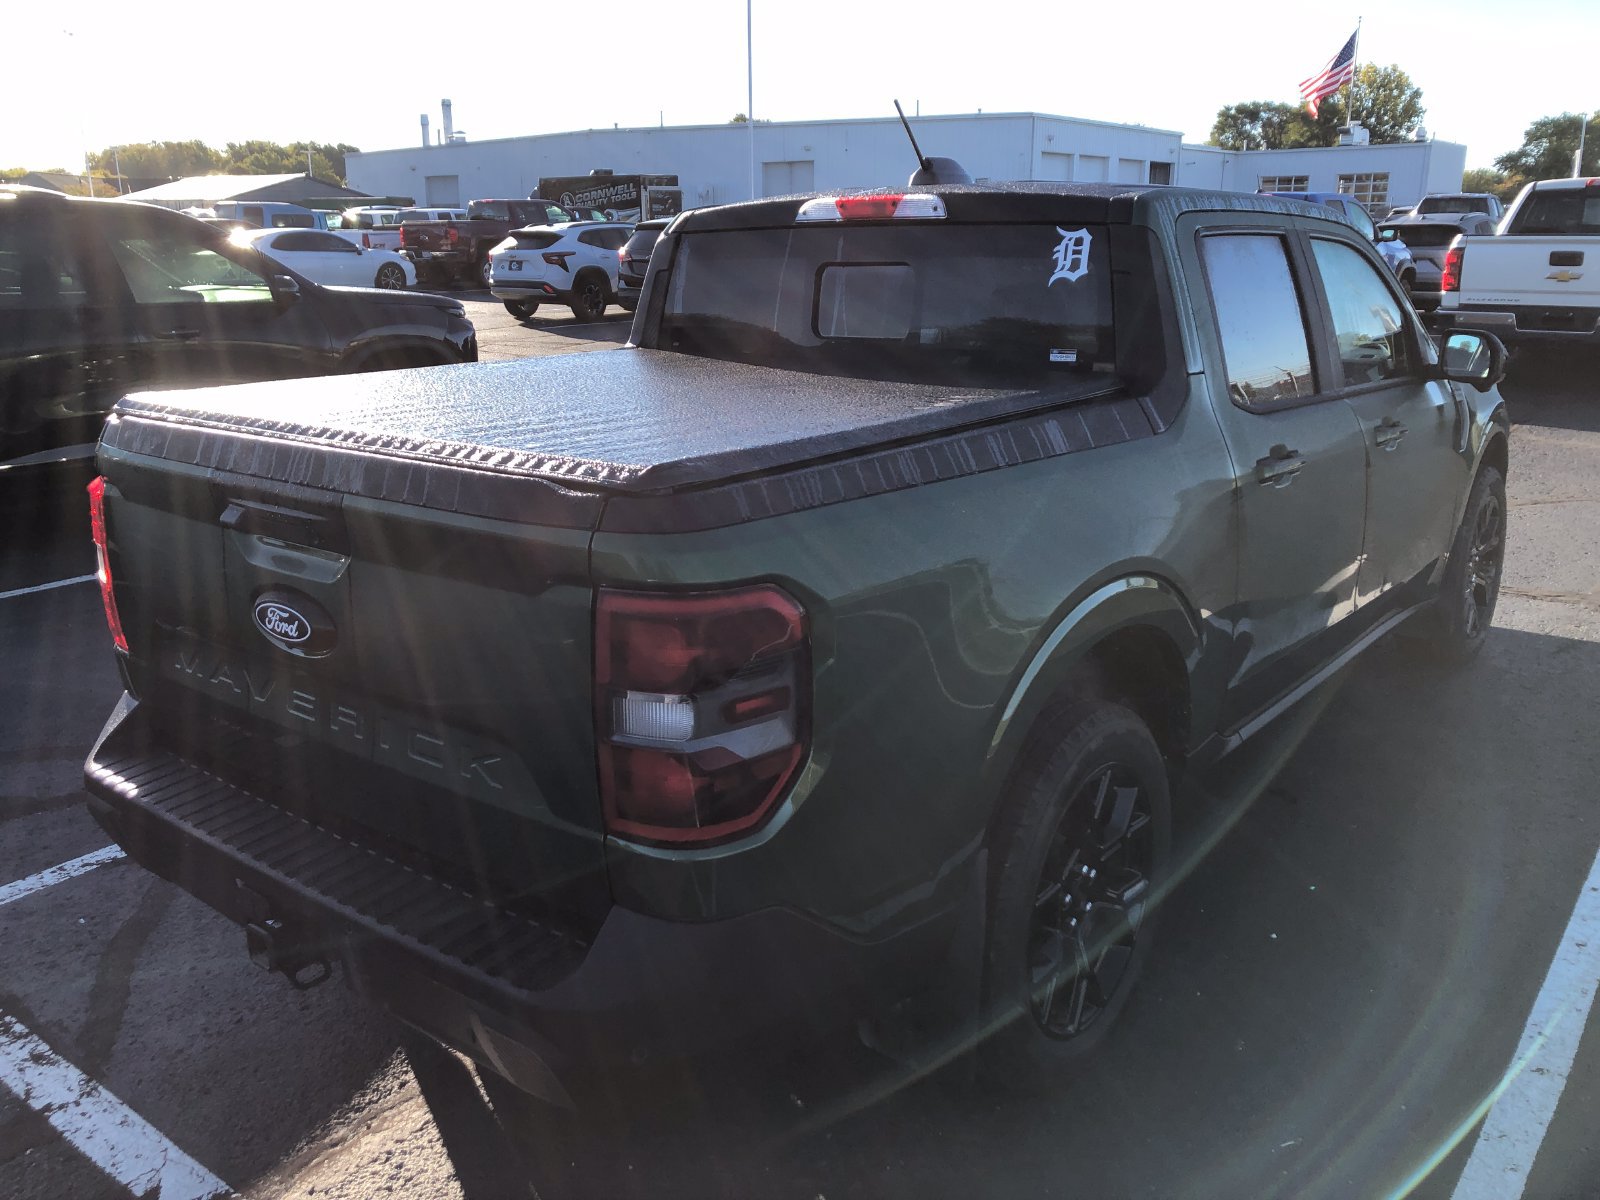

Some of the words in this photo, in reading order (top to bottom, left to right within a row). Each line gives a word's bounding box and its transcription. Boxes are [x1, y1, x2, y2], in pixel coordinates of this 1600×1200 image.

[575, 182, 636, 202] CORNWELL
[611, 191, 637, 203] TOOLS
[265, 606, 299, 637] Ford
[174, 650, 503, 789] MAVERICK
